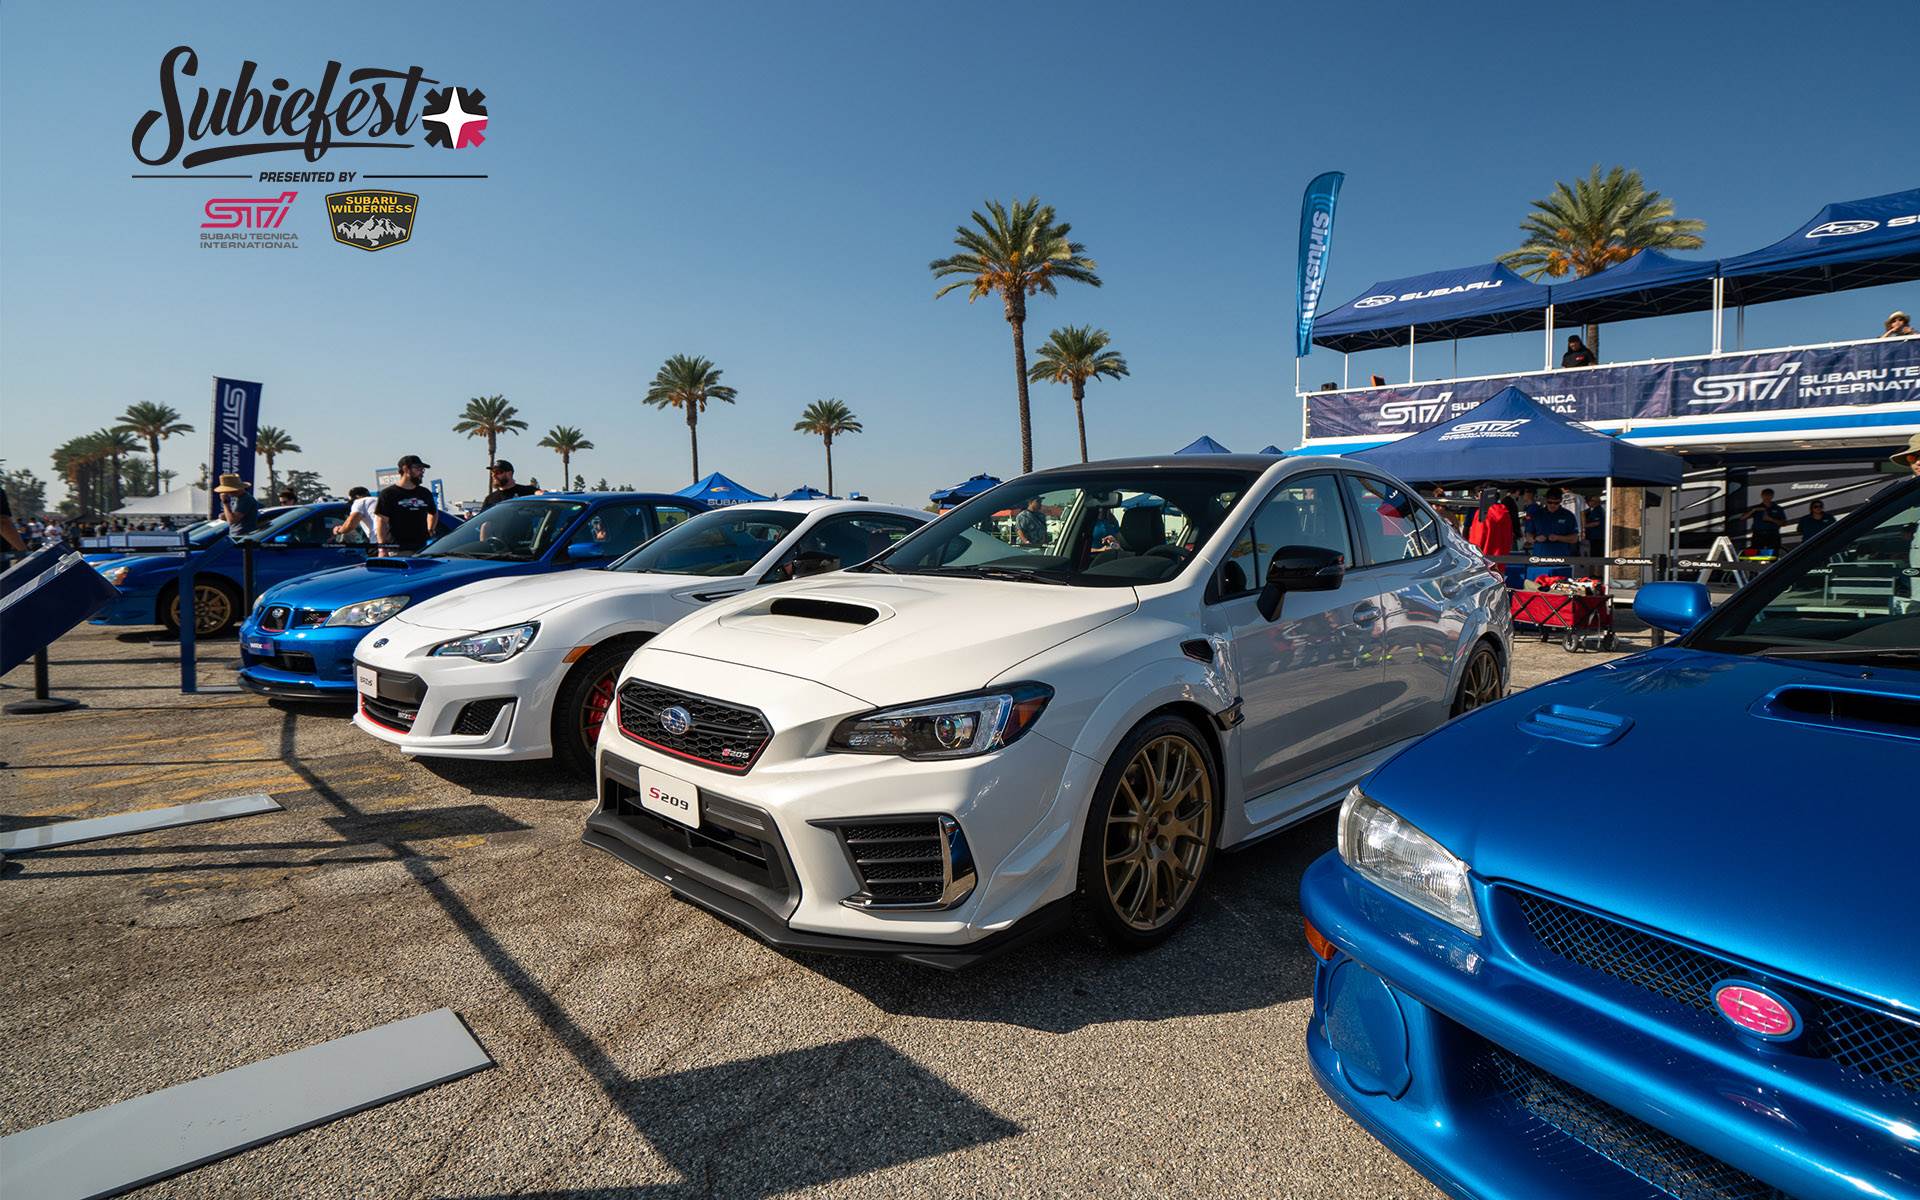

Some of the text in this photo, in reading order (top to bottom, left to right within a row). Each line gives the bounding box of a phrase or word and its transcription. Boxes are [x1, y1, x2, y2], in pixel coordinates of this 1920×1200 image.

[1398, 279, 1503, 302] SUBARU
[1800, 368, 1888, 386] SUBARU
[722, 748, 749, 759] S209
[649, 787, 689, 810] S209
